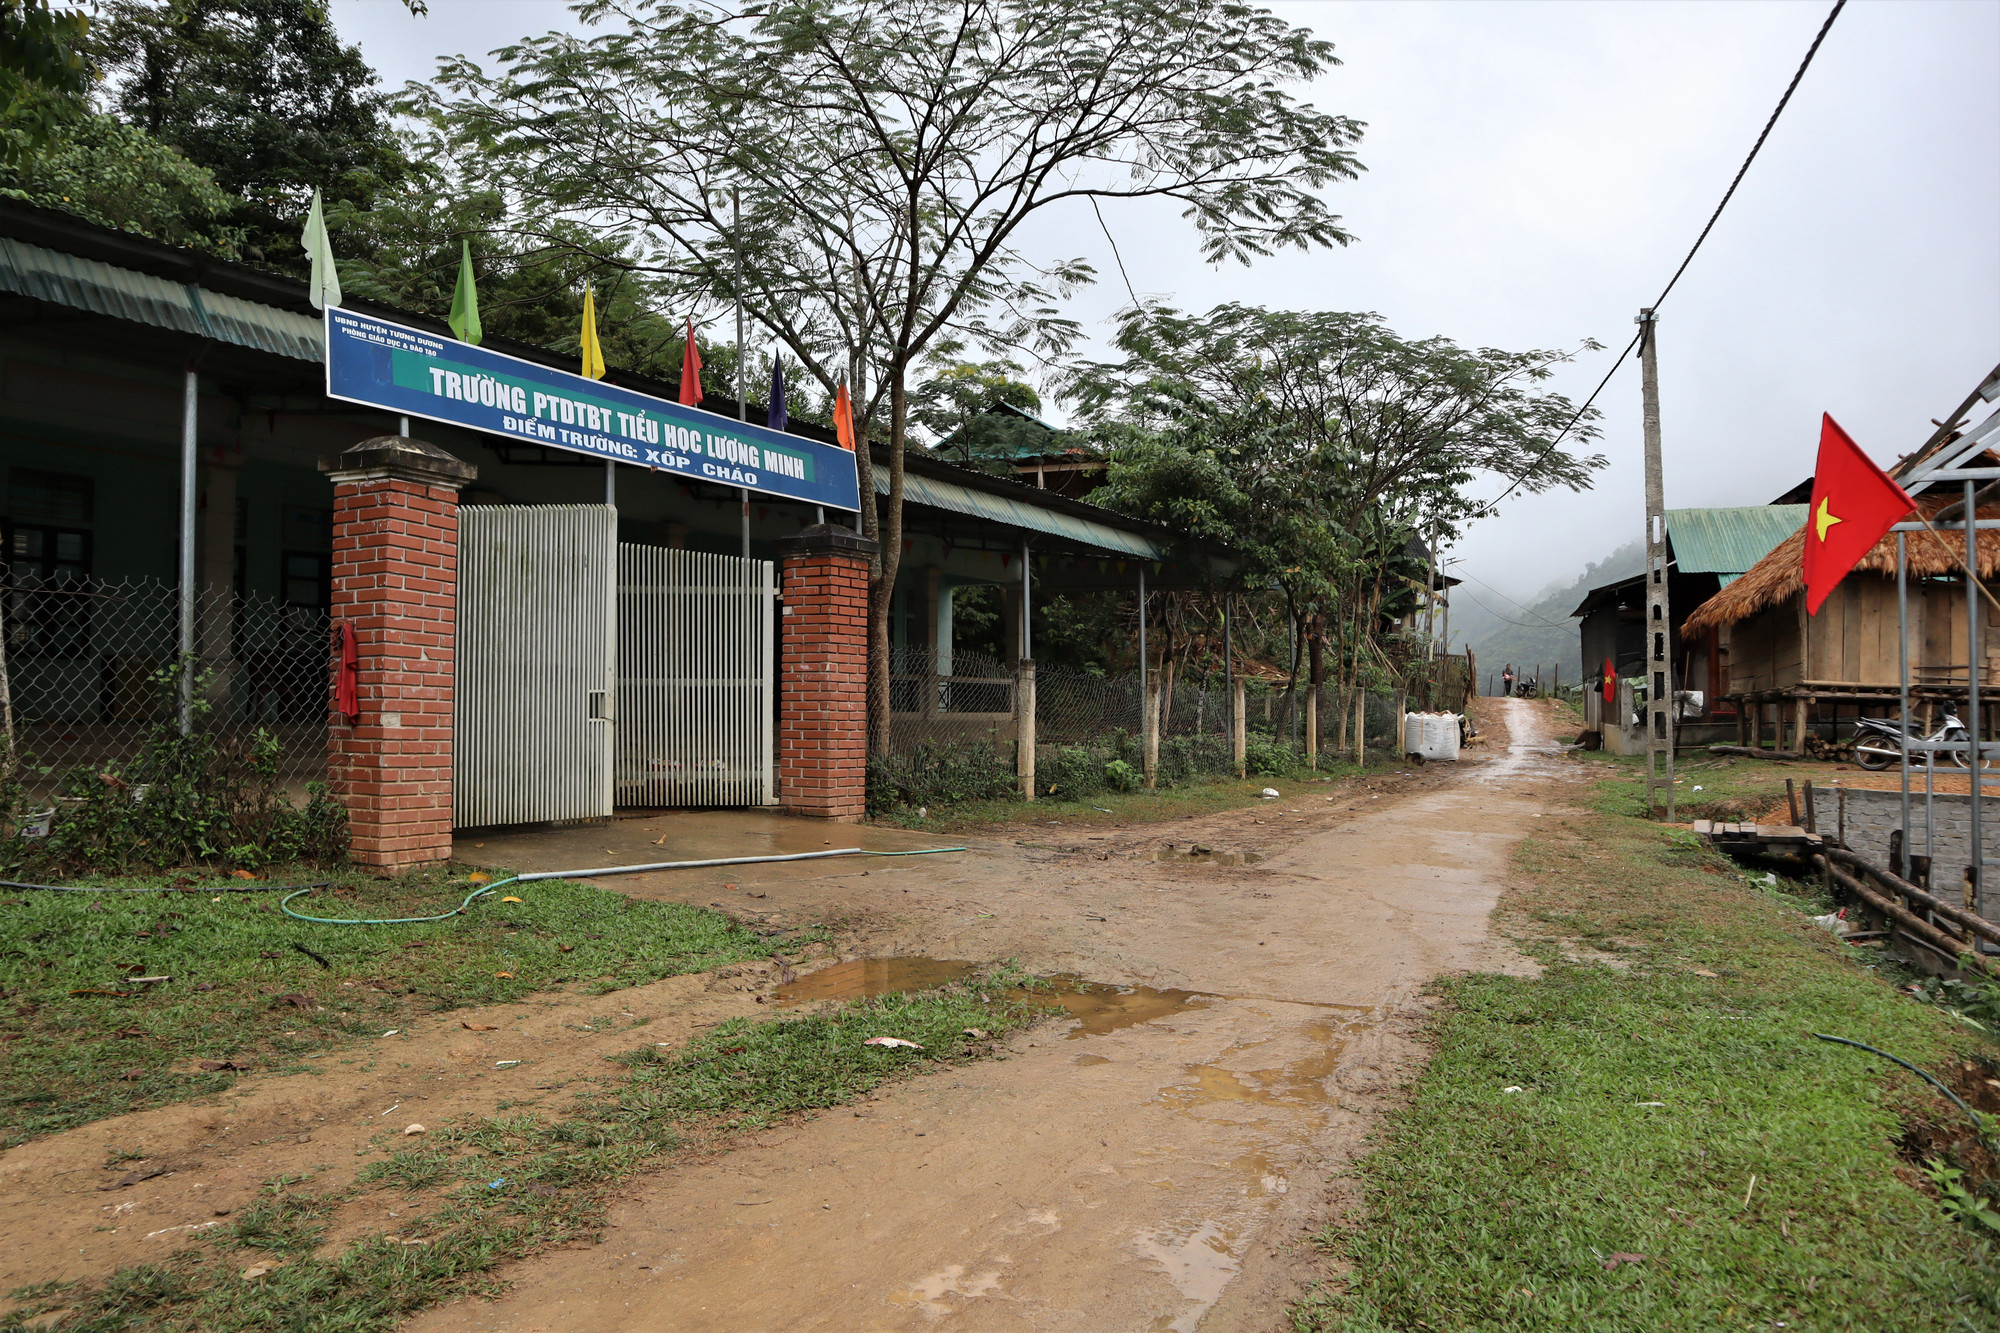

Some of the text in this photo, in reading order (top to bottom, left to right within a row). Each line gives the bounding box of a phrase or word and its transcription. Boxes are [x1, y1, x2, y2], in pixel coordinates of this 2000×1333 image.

[335, 316, 444, 350] UBND HUYỆN TƯƠNG DƯƠNG
[341, 326, 367, 339] PHÒNG
[368, 333, 385, 343] GIÁO
[386, 338, 401, 347] DỤC
[425, 348, 437, 357] TẠO
[429, 366, 805, 480] TRƯỜNG PTDTBT TIỂU HỌC LƯỢNG MINH
[502, 416, 758, 485] ĐIỂM TRƯỜNG: XỐP CHÁO
